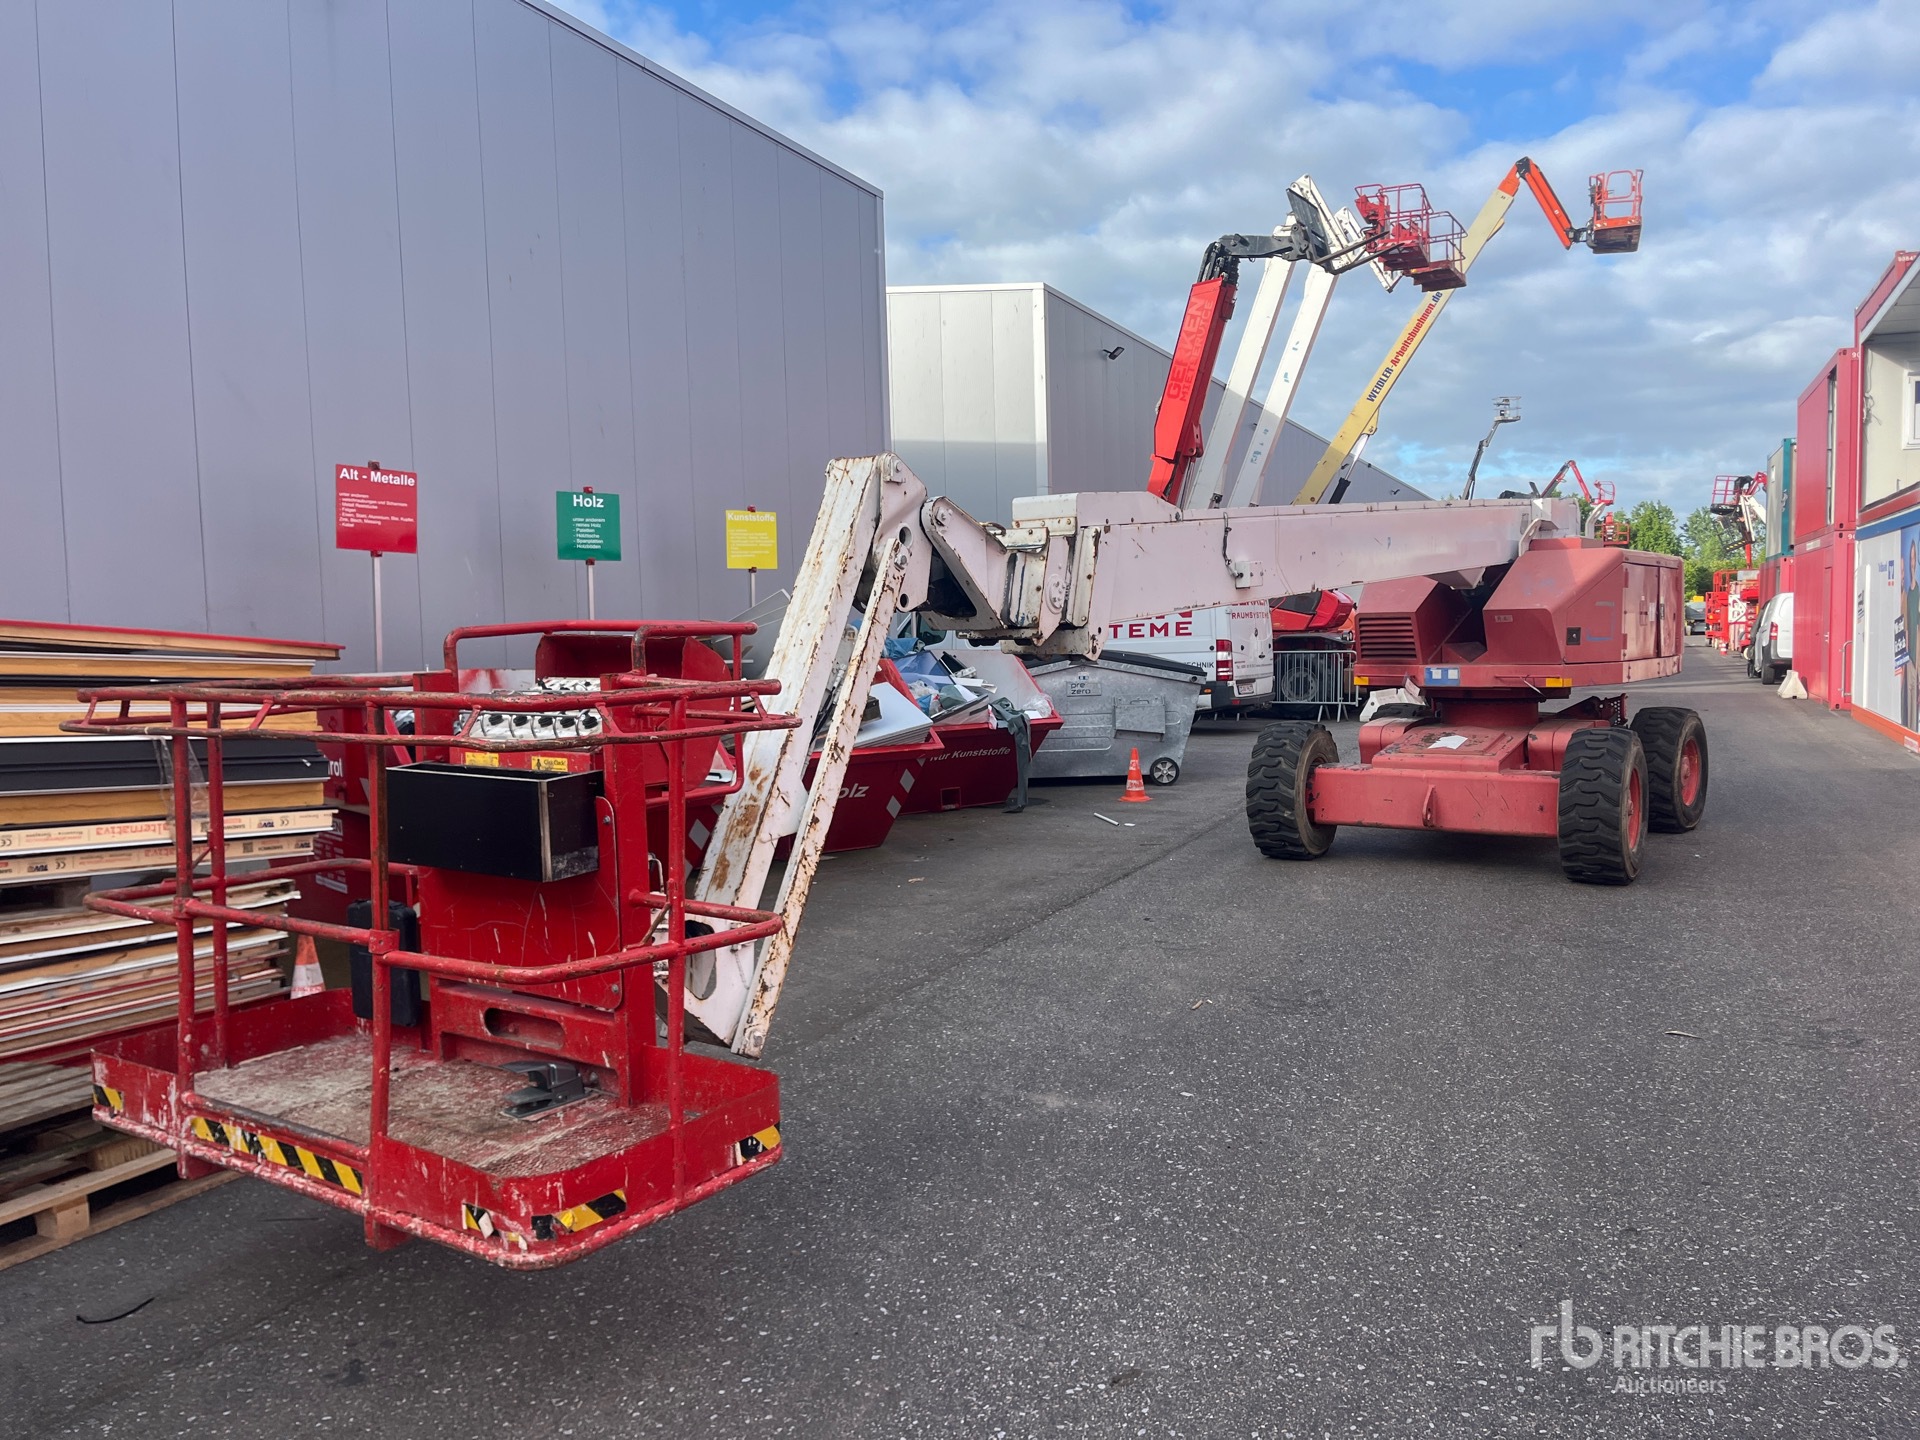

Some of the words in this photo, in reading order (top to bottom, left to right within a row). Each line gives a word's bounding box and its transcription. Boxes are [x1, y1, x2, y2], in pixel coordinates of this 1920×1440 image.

[1167, 294, 1206, 399] GERKEN
[340, 468, 359, 480] Alt
[370, 471, 415, 486] Metalle
[573, 494, 604, 508] Holz
[728, 513, 775, 522] Kunststoffe
[1109, 621, 1193, 639] TEME
[951, 746, 1011, 758] Kunststoffe
[838, 783, 870, 798] olz
